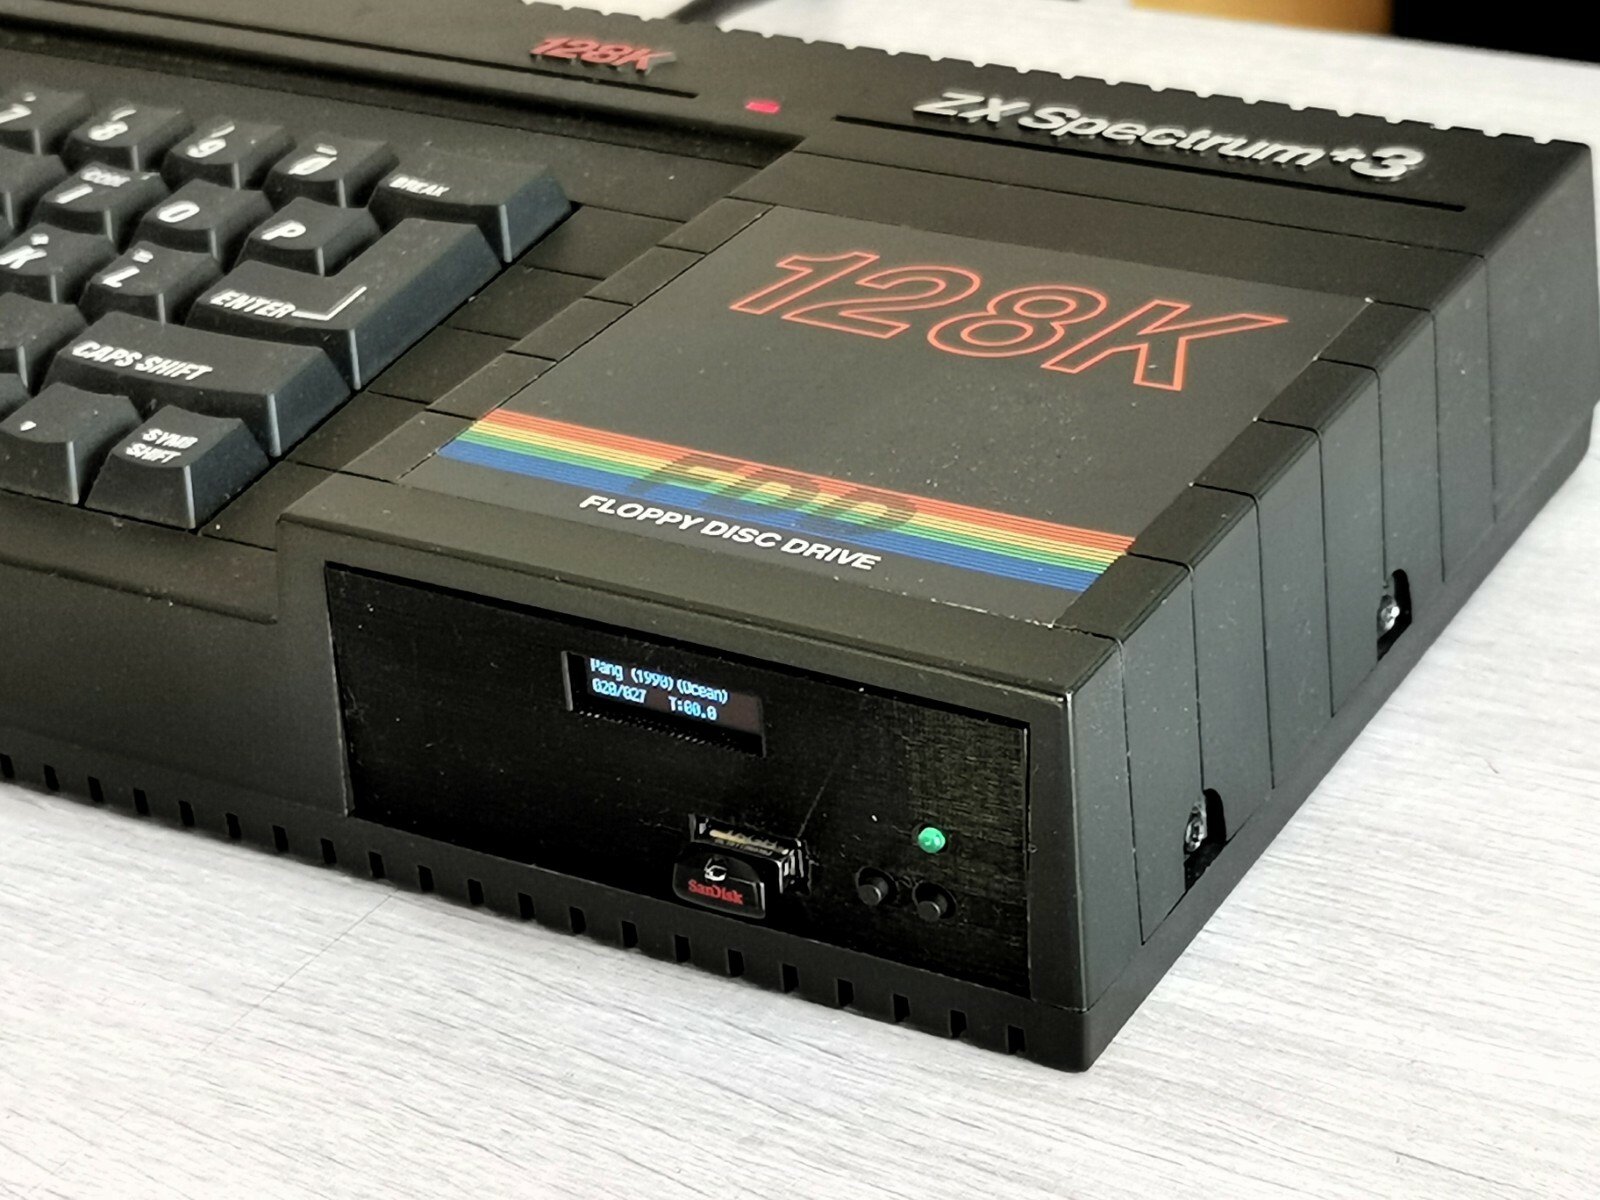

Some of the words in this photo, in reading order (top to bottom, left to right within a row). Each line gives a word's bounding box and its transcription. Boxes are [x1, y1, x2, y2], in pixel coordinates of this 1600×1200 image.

[530, 37, 674, 74] 128K
[914, 91, 1032, 124] ZX
[388, 175, 451, 198] BREAK
[261, 220, 307, 241] P
[209, 289, 297, 319] ENTER
[730, 250, 1290, 392] 128K
[72, 340, 143, 368] CAPS
[136, 355, 214, 381] SHIFT
[125, 442, 182, 464] SHIFT
[579, 494, 704, 531] FLOPPY
[700, 519, 783, 549] DISC
[780, 536, 882, 571] DRIVE
[590, 657, 624, 682] Pang
[687, 879, 744, 905] SanDisk
